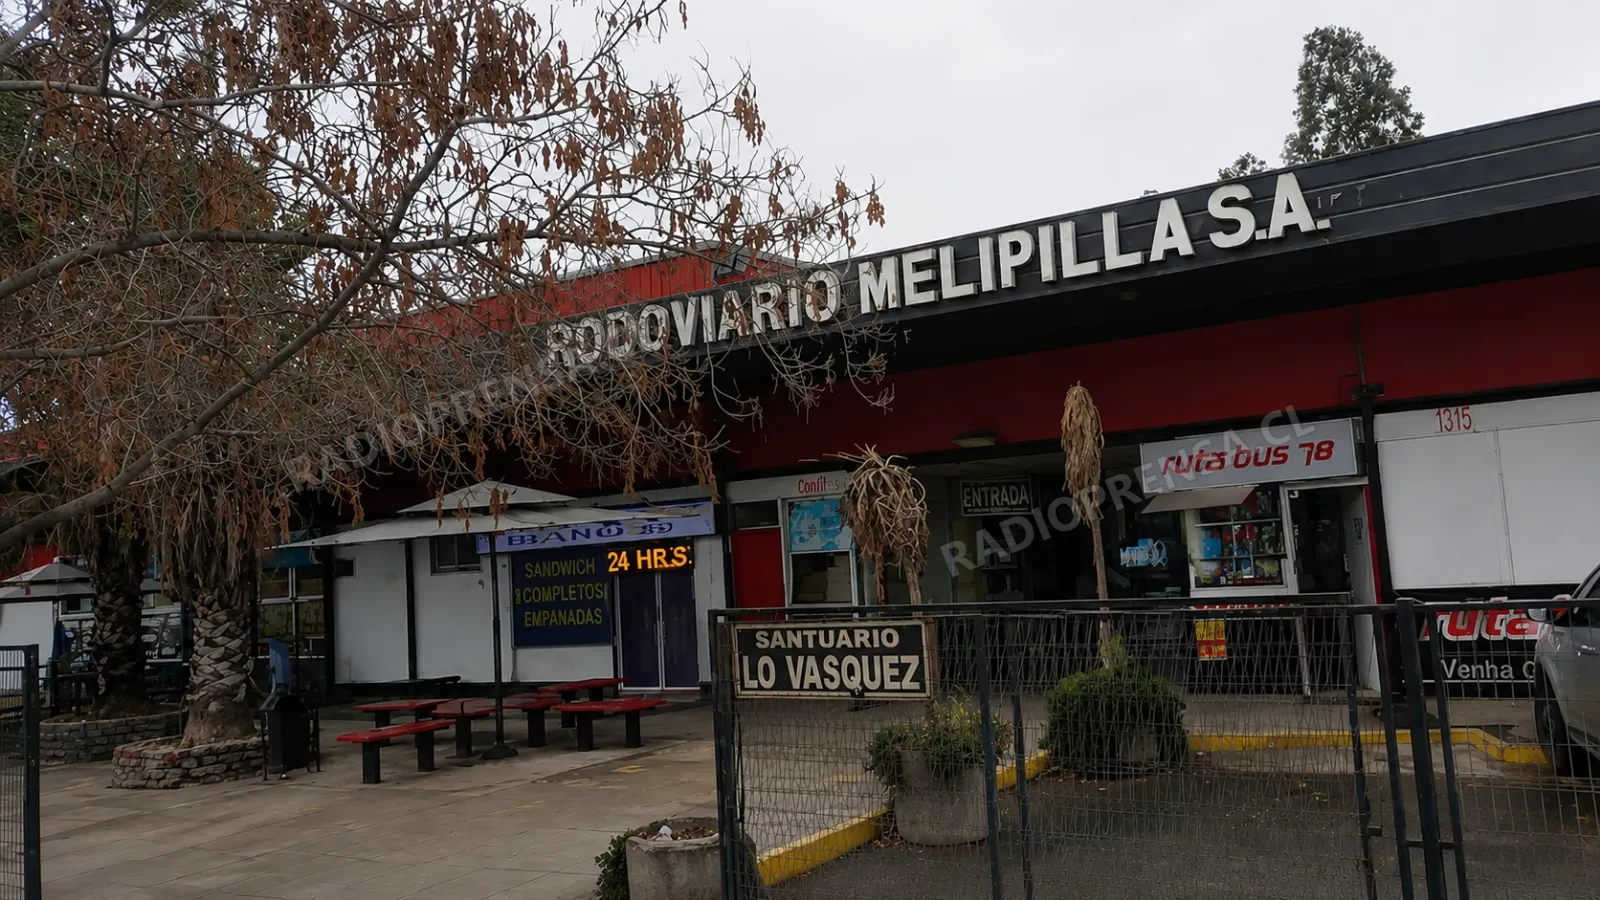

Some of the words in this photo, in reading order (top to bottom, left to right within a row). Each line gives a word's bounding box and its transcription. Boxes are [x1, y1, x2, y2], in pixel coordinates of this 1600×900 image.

[545, 269, 841, 368] RODOVIARIO
[858, 198, 1194, 314] MELIPILLA
[1207, 173, 1331, 249] S.A.
[1435, 406, 1472, 433] 1315
[1161, 448, 1227, 476] ruta
[1233, 443, 1290, 470] bus
[1299, 438, 1335, 467] 78
[963, 484, 1030, 508] ENTRADA
[524, 557, 595, 578] SANDWICH
[607, 551, 630, 572] 24
[522, 583, 605, 604] COMPLETOS
[524, 608, 603, 627] EMPANADAS
[755, 628, 900, 650] SANTUARIO
[741, 656, 776, 690] LO
[786, 654, 921, 691] VASQUEZ
